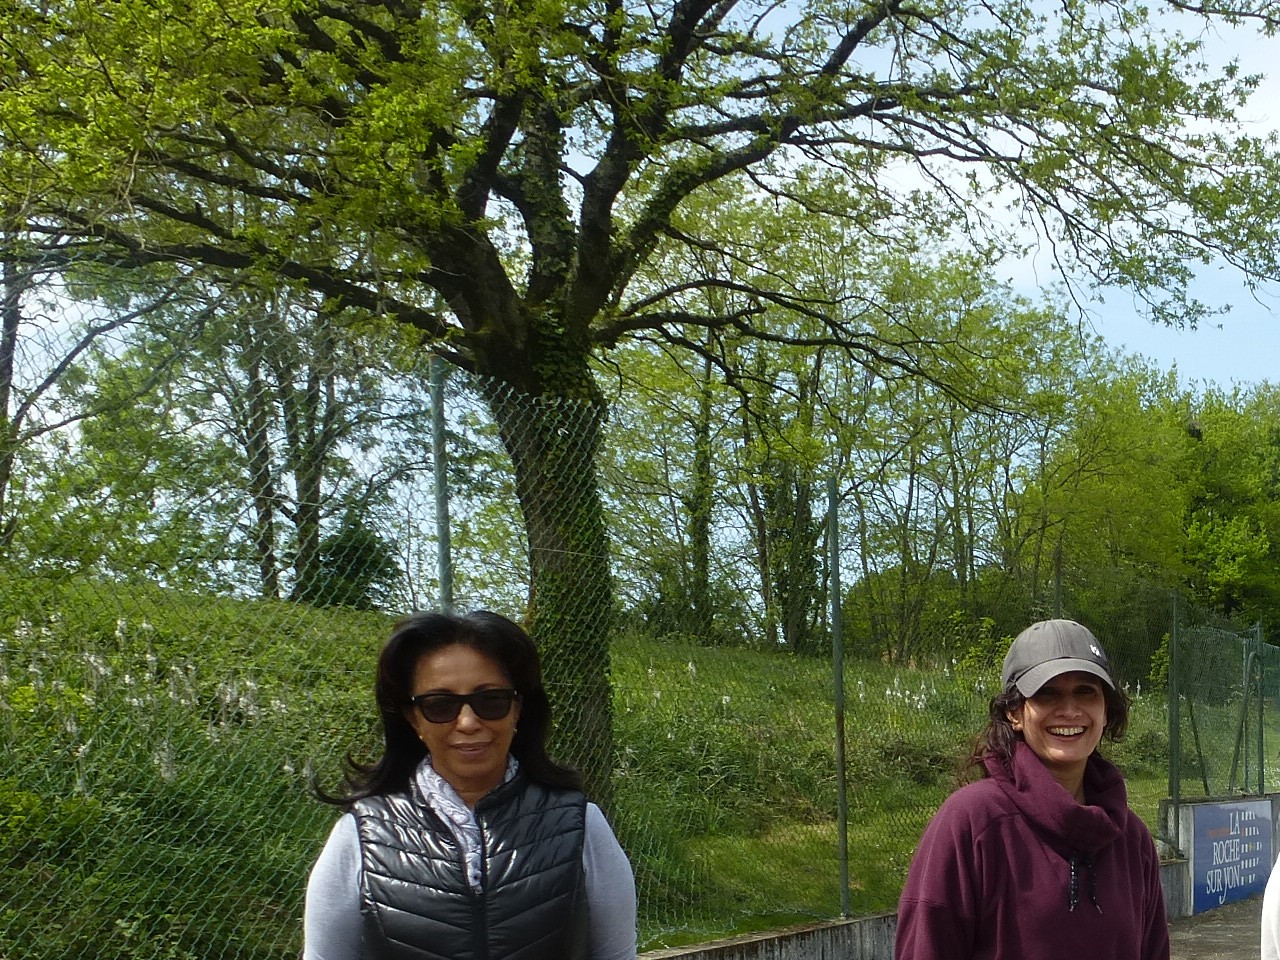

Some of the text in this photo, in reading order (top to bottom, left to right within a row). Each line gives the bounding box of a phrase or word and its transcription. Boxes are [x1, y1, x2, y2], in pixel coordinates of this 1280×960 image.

[1230, 811, 1240, 835] LA
[1213, 838, 1240, 866] ROCHE
[1206, 868, 1222, 895] SUR
